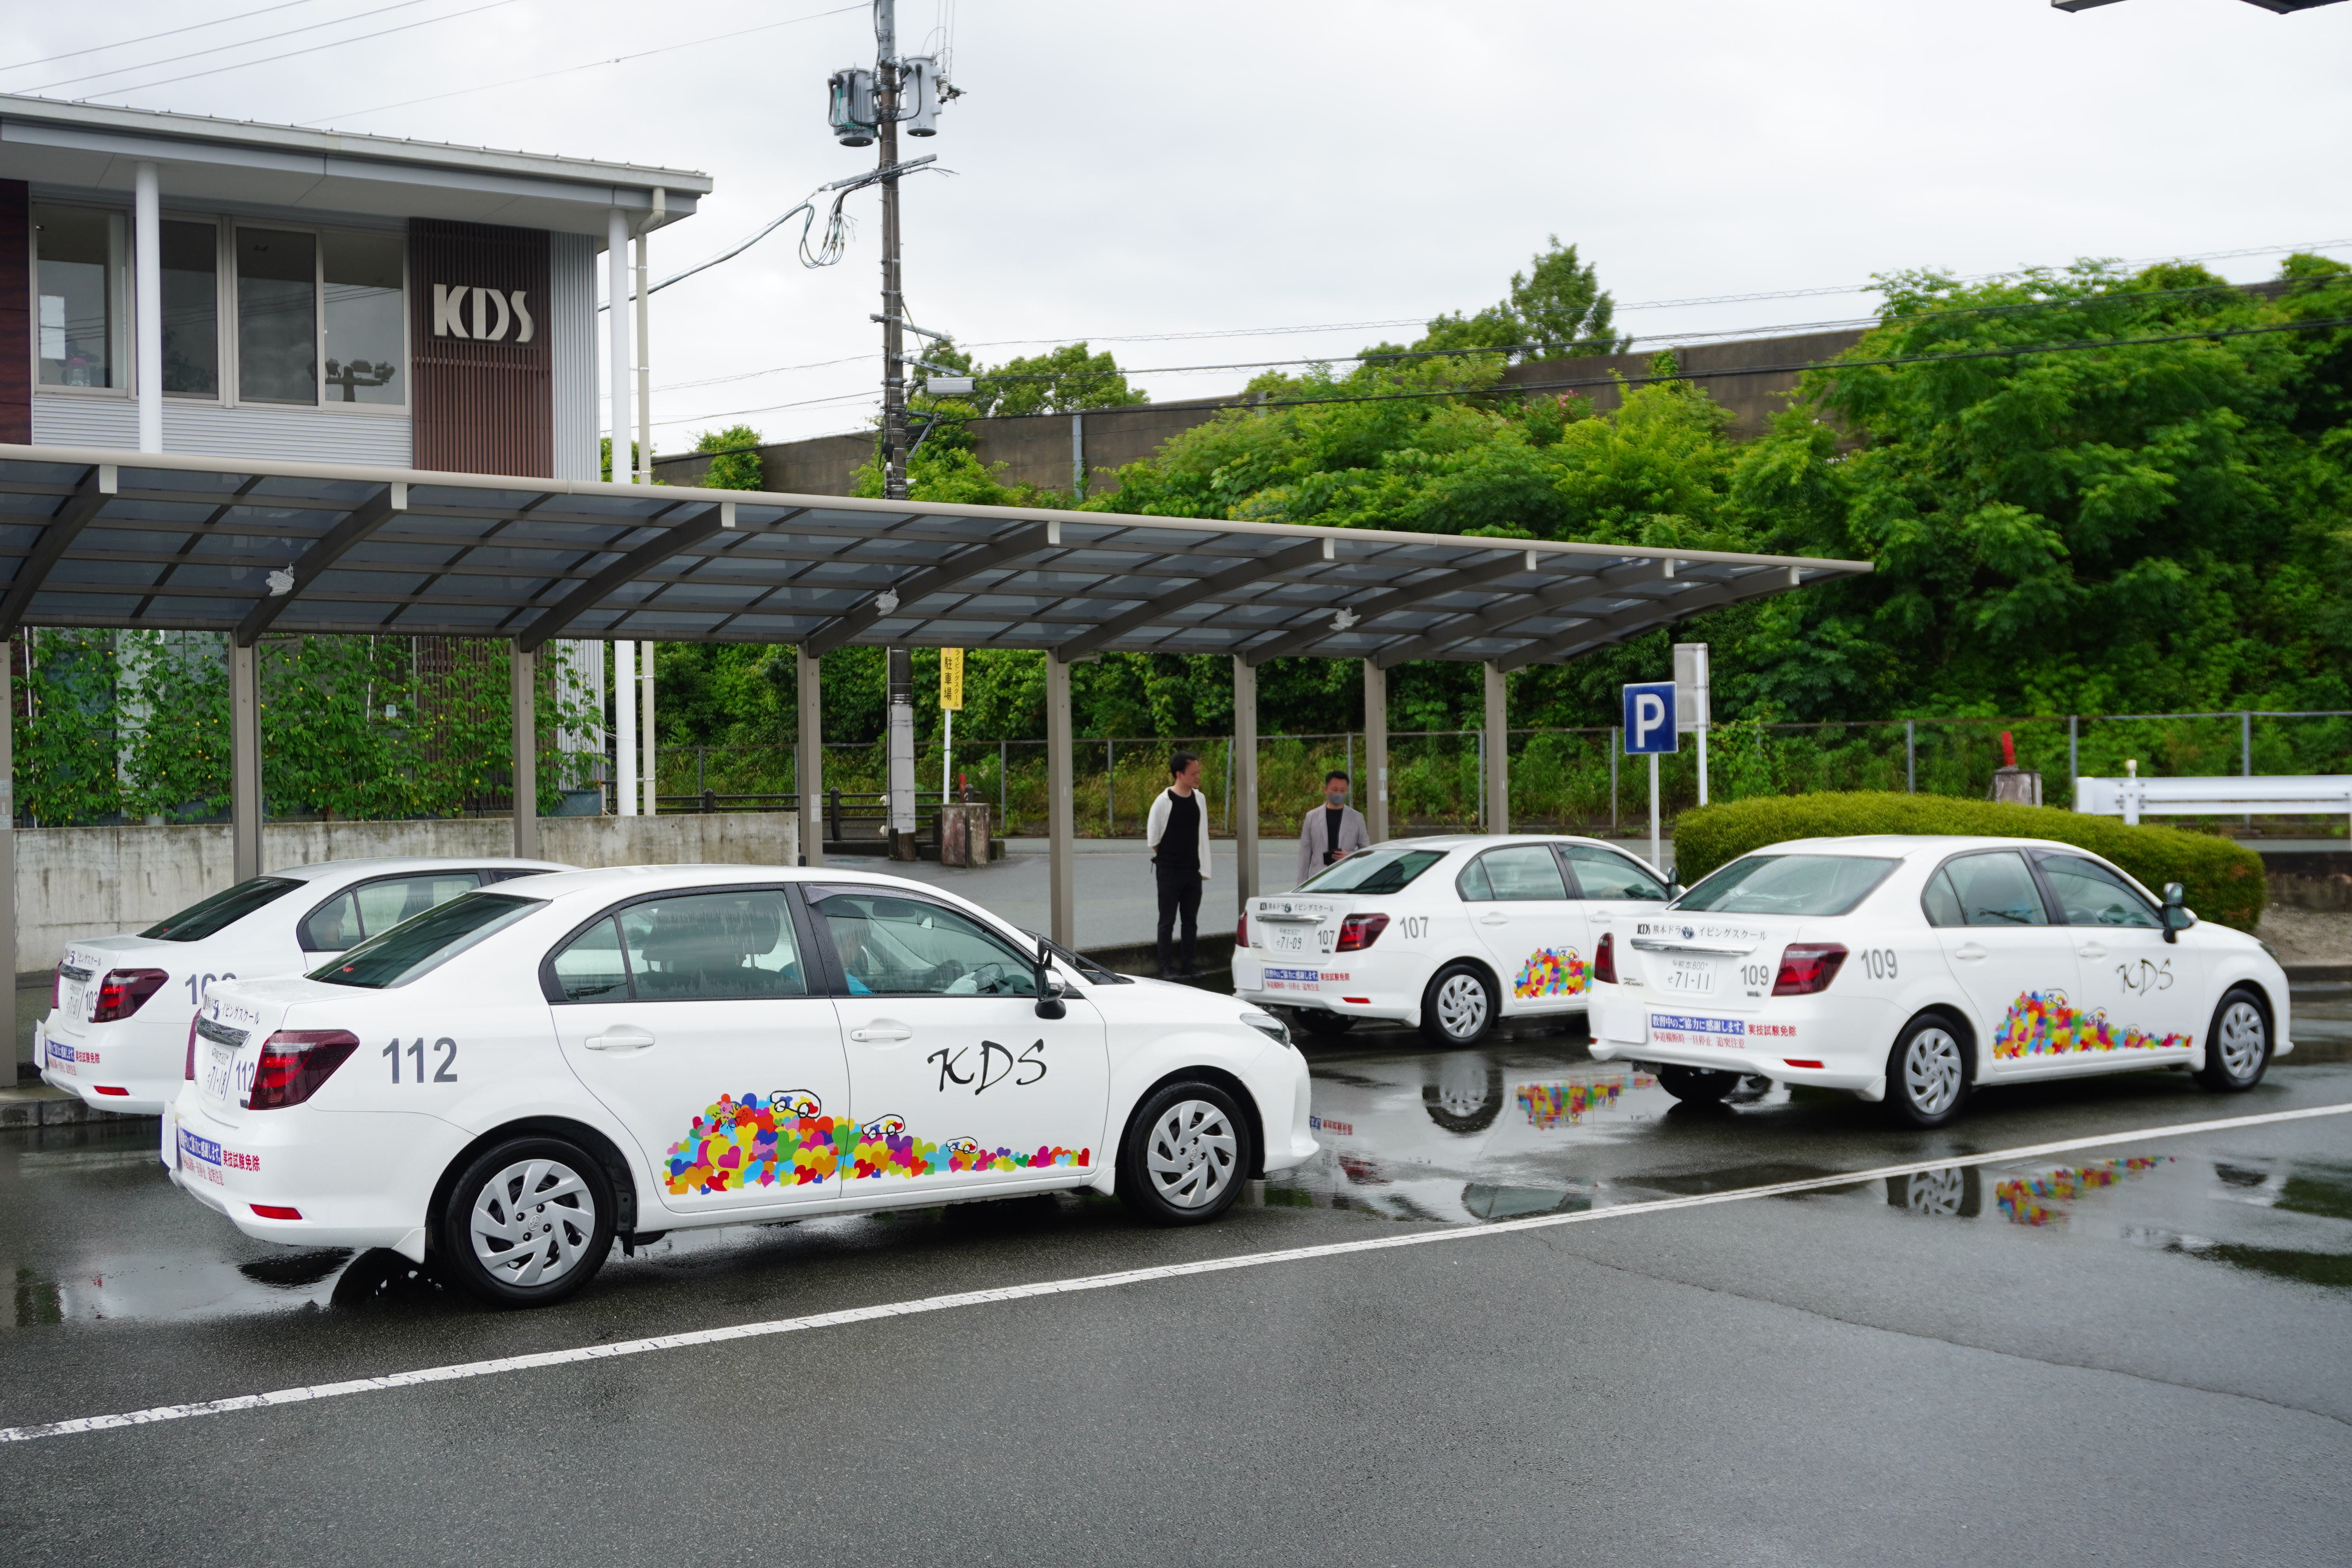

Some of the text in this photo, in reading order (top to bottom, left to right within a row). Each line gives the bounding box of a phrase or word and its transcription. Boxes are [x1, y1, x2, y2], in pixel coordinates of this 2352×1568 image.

[434, 283, 534, 342] KDS
[944, 657, 953, 701] 駐車場
[1636, 693, 1665, 747] P
[1318, 930, 1335, 945] 107
[1400, 916, 1429, 938] 107
[1741, 964, 1769, 985] 109
[1861, 948, 1898, 979] 109
[185, 973, 236, 1004] 10
[1320, 973, 1350, 981] 実技試験免除
[2116, 958, 2173, 996] KDS
[85, 990, 98, 1011] 103
[1653, 1014, 1744, 1034] 教習中のご協力に感謝します。
[1749, 1024, 1797, 1037] 実技試験免除
[1654, 1031, 1746, 1049] 歩道横断時一旦停止 追突注意
[383, 1037, 457, 1083] 112
[927, 1038, 1047, 1095] KDS
[236, 1060, 254, 1093] 112
[727, 1110, 748, 1131] KDS
[223, 1149, 260, 1172] 実技試験免除
